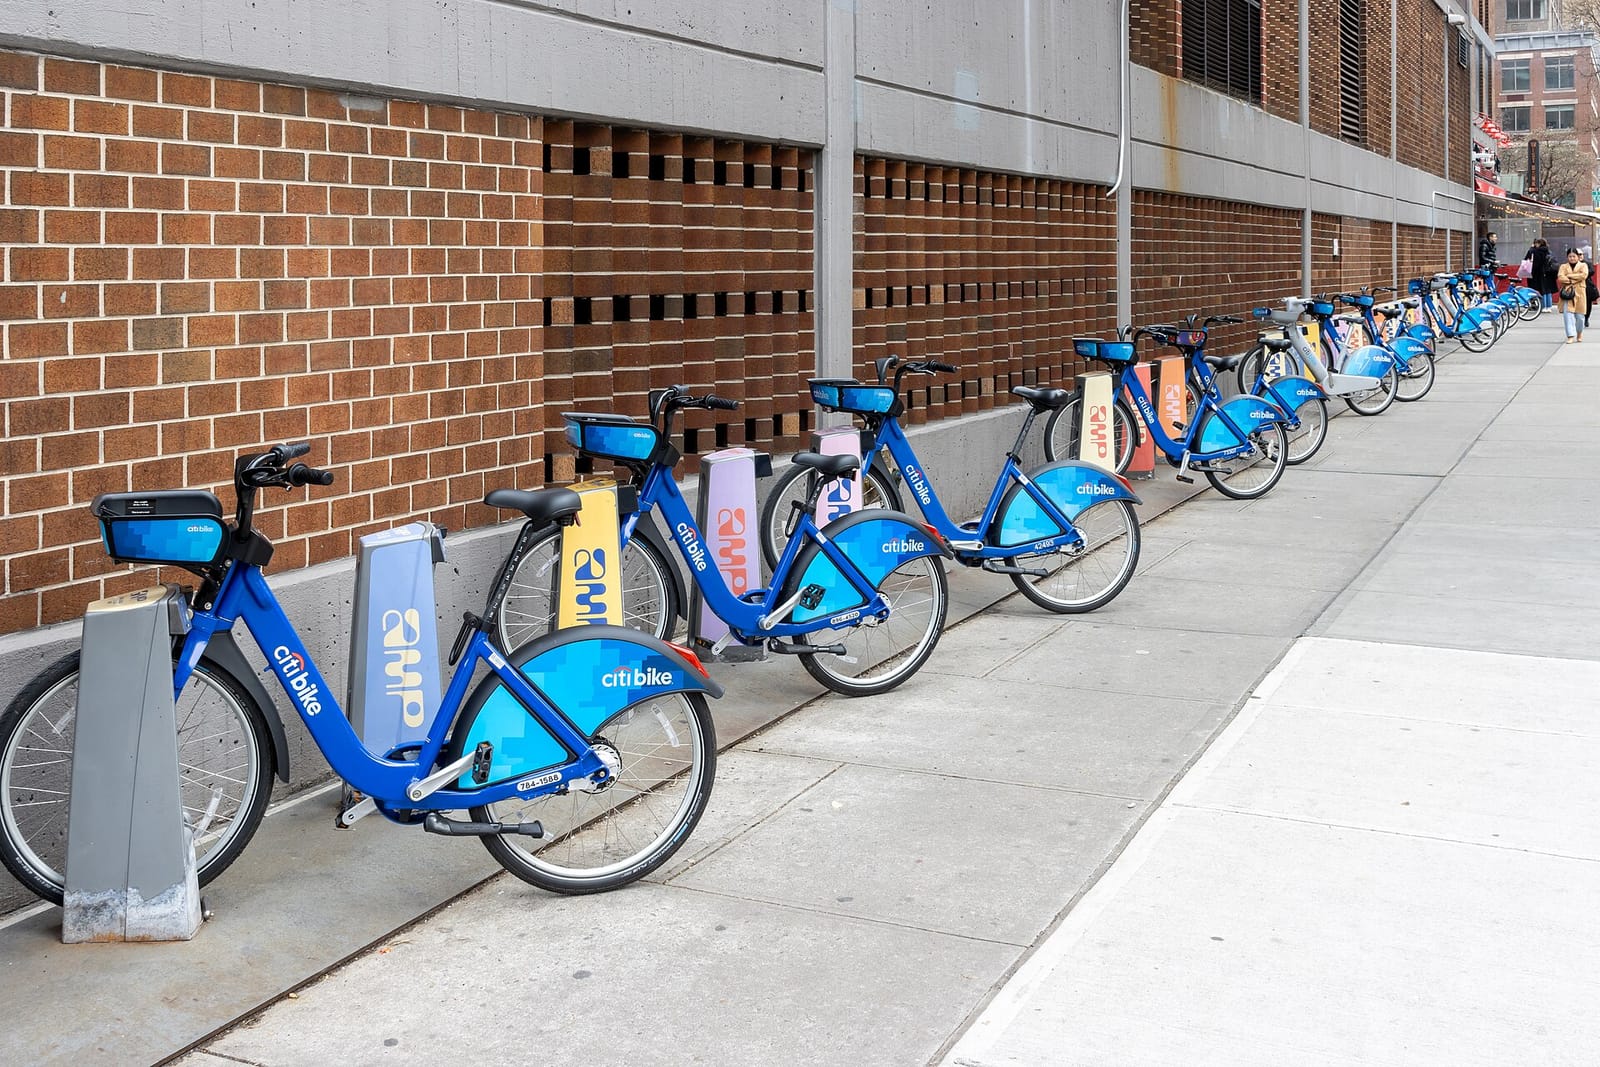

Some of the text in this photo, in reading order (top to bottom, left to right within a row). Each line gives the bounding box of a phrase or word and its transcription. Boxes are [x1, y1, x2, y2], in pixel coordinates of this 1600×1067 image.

[1089, 405, 1107, 458] amp
[382, 608, 424, 727] amp
[520, 774, 559, 790] 784-1588
